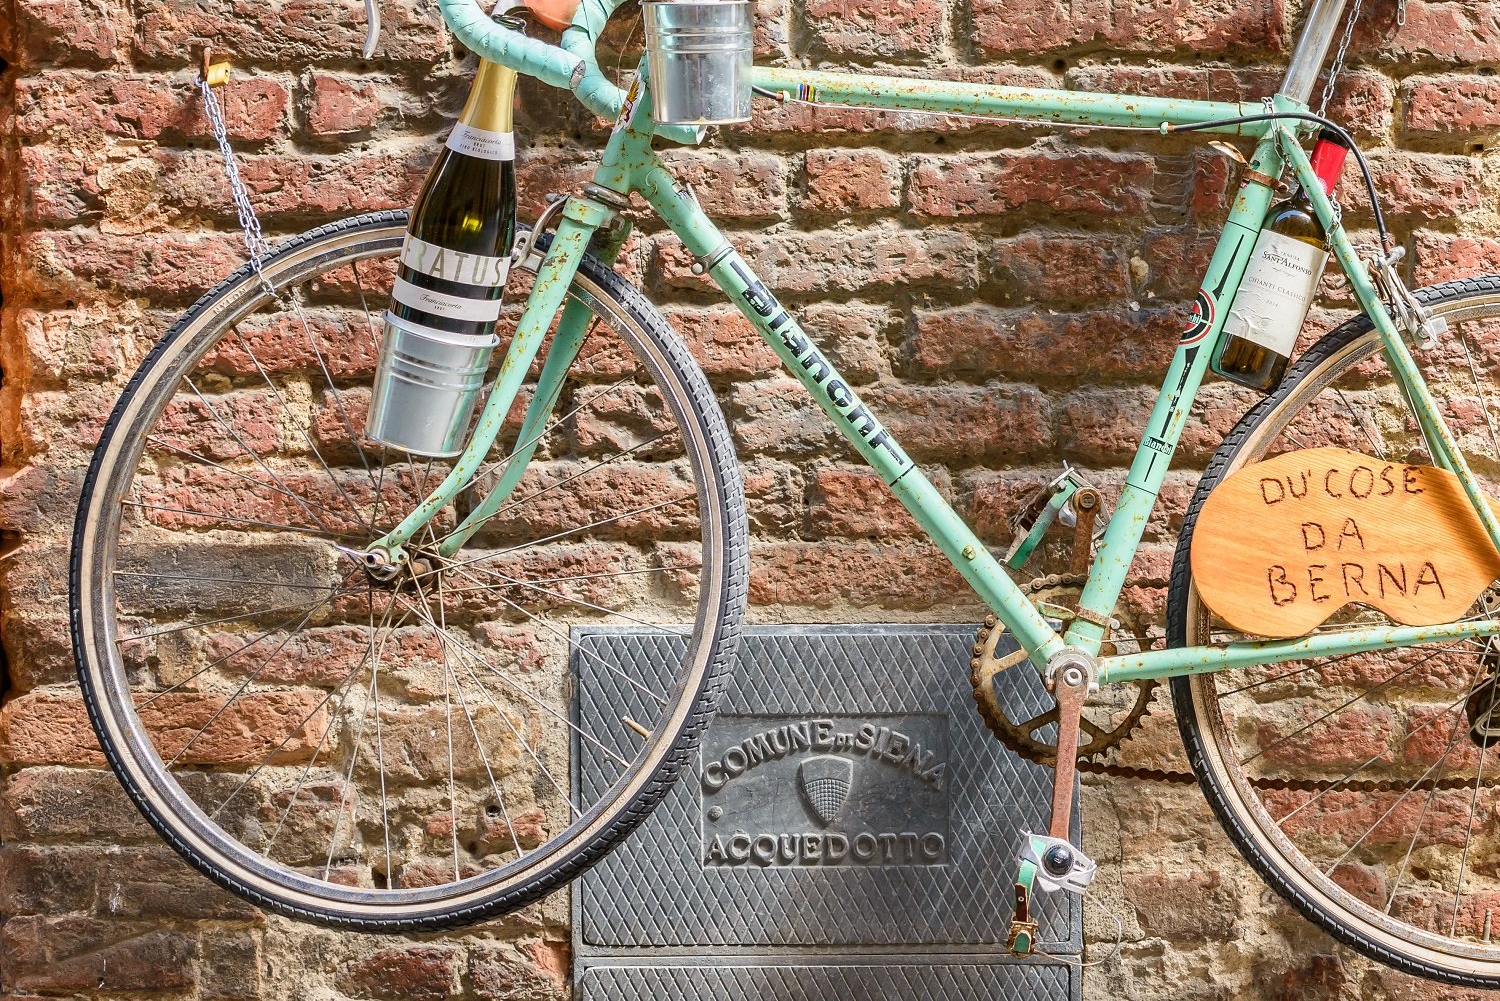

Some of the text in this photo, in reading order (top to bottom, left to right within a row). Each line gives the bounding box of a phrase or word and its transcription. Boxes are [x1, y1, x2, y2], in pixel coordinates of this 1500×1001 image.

[463, 130, 502, 145] Franciacorta
[1261, 250, 1312, 276] SANT'ALFONSO
[419, 293, 463, 310] Franciacorta
[1248, 276, 1306, 303] CHIANTI CLASSICO
[1323, 465, 1426, 500] COSE
[1301, 517, 1365, 552] DA
[1267, 561, 1446, 607] BERNA
[702, 719, 835, 789] COMUNE
[854, 722, 947, 791] SIENA
[706, 831, 946, 864] ACQUEDOTTO
